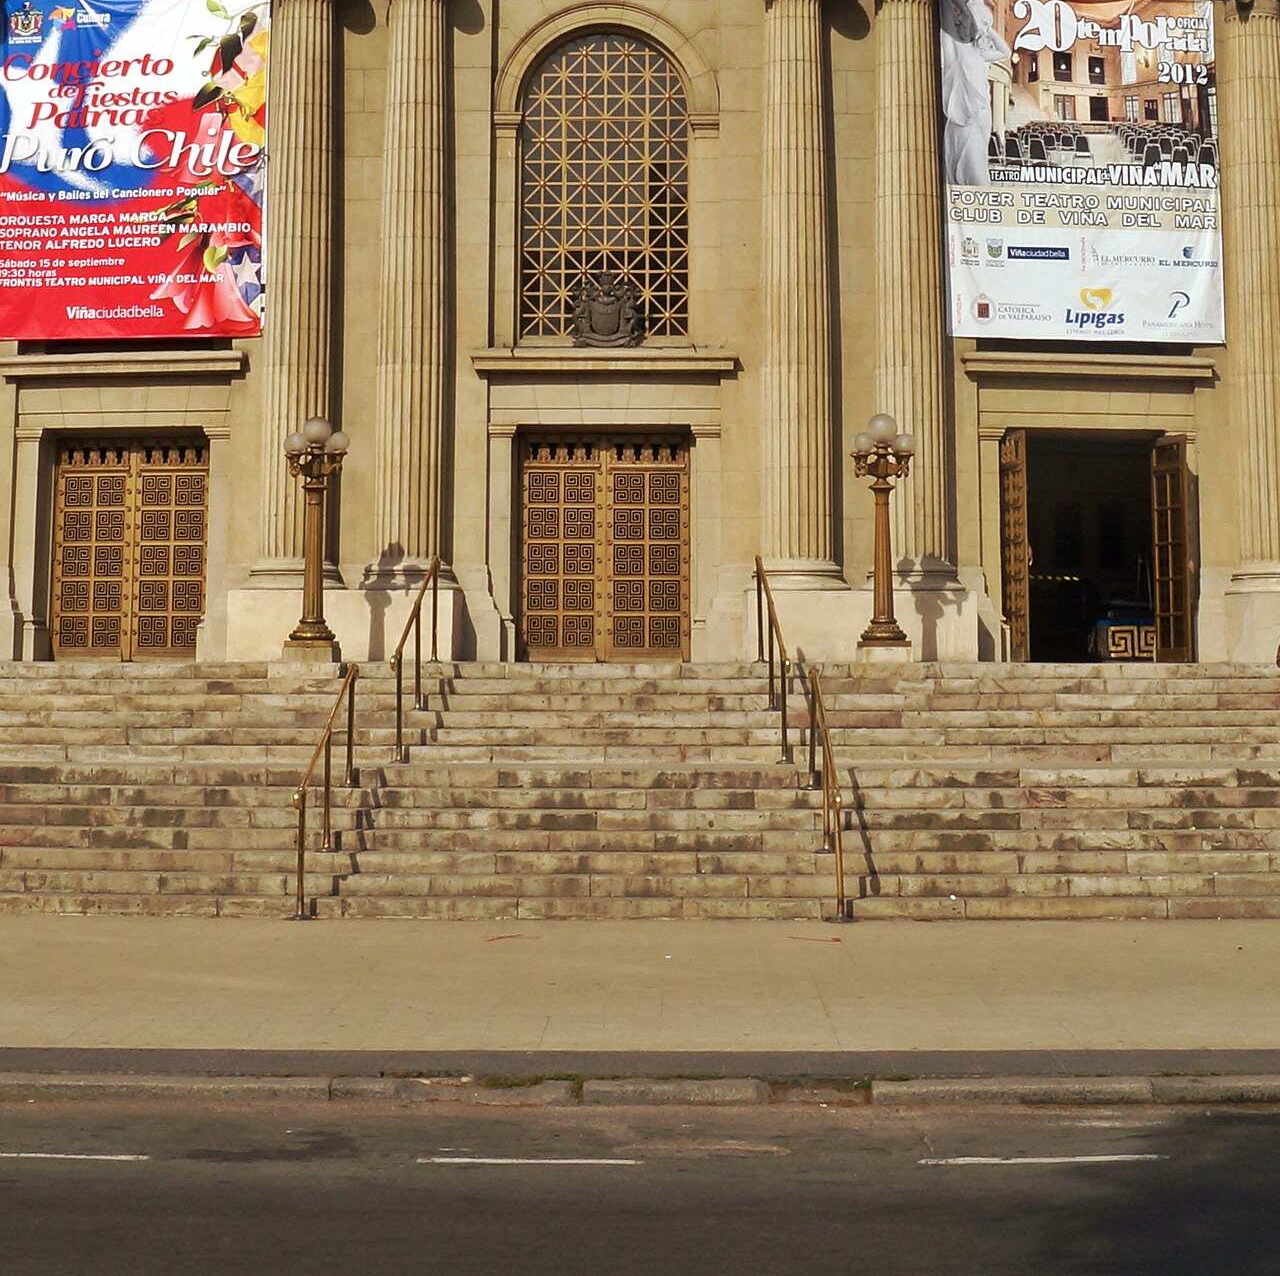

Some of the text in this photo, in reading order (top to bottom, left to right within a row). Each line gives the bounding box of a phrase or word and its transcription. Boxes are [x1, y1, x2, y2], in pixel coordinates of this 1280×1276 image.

[3, 49, 174, 83] Concierto
[1157, 62, 1208, 85] 2012
[48, 81, 179, 109] de Fiestas
[26, 101, 166, 130] Patrias
[131, 129, 258, 176] Chile
[989, 170, 1021, 182] TEATRO
[1020, 165, 1104, 185] MUNICIPAL
[1160, 160, 1217, 188] MAR
[48, 193, 56, 202] y
[58, 190, 90, 200] Bailes
[93, 189, 108, 199] del
[111, 188, 174, 199] Cancionero
[949, 189, 1217, 213] FOYER TEATRO MUNICIPAL
[0, 211, 167, 226] ORQUESTA MARGA MARGA
[949, 207, 1217, 229] CLUB DE VIÑA DEL MAR
[0, 222, 251, 238] SOPRANO ANGELA MAUREEN MARAMBIO
[0, 237, 161, 250] TENOR ALFREDO LUCERO
[39, 258, 50, 268] 15
[52, 258, 66, 267] de
[68, 257, 125, 269] septiembre
[1112, 255, 1156, 264] MERCURIO
[1158, 259, 1171, 267] EL
[1172, 260, 1219, 268] MERCURIO
[28, 269, 57, 278] horas
[45, 277, 86, 287] TEATRO
[88, 275, 146, 286] MUNICIPAL
[147, 273, 174, 284] VIÑA
[176, 274, 198, 284] DEL
[199, 273, 224, 283] MAR
[66, 304, 165, 319] Viñaciudadbella
[1065, 308, 1125, 329] Lipigas
